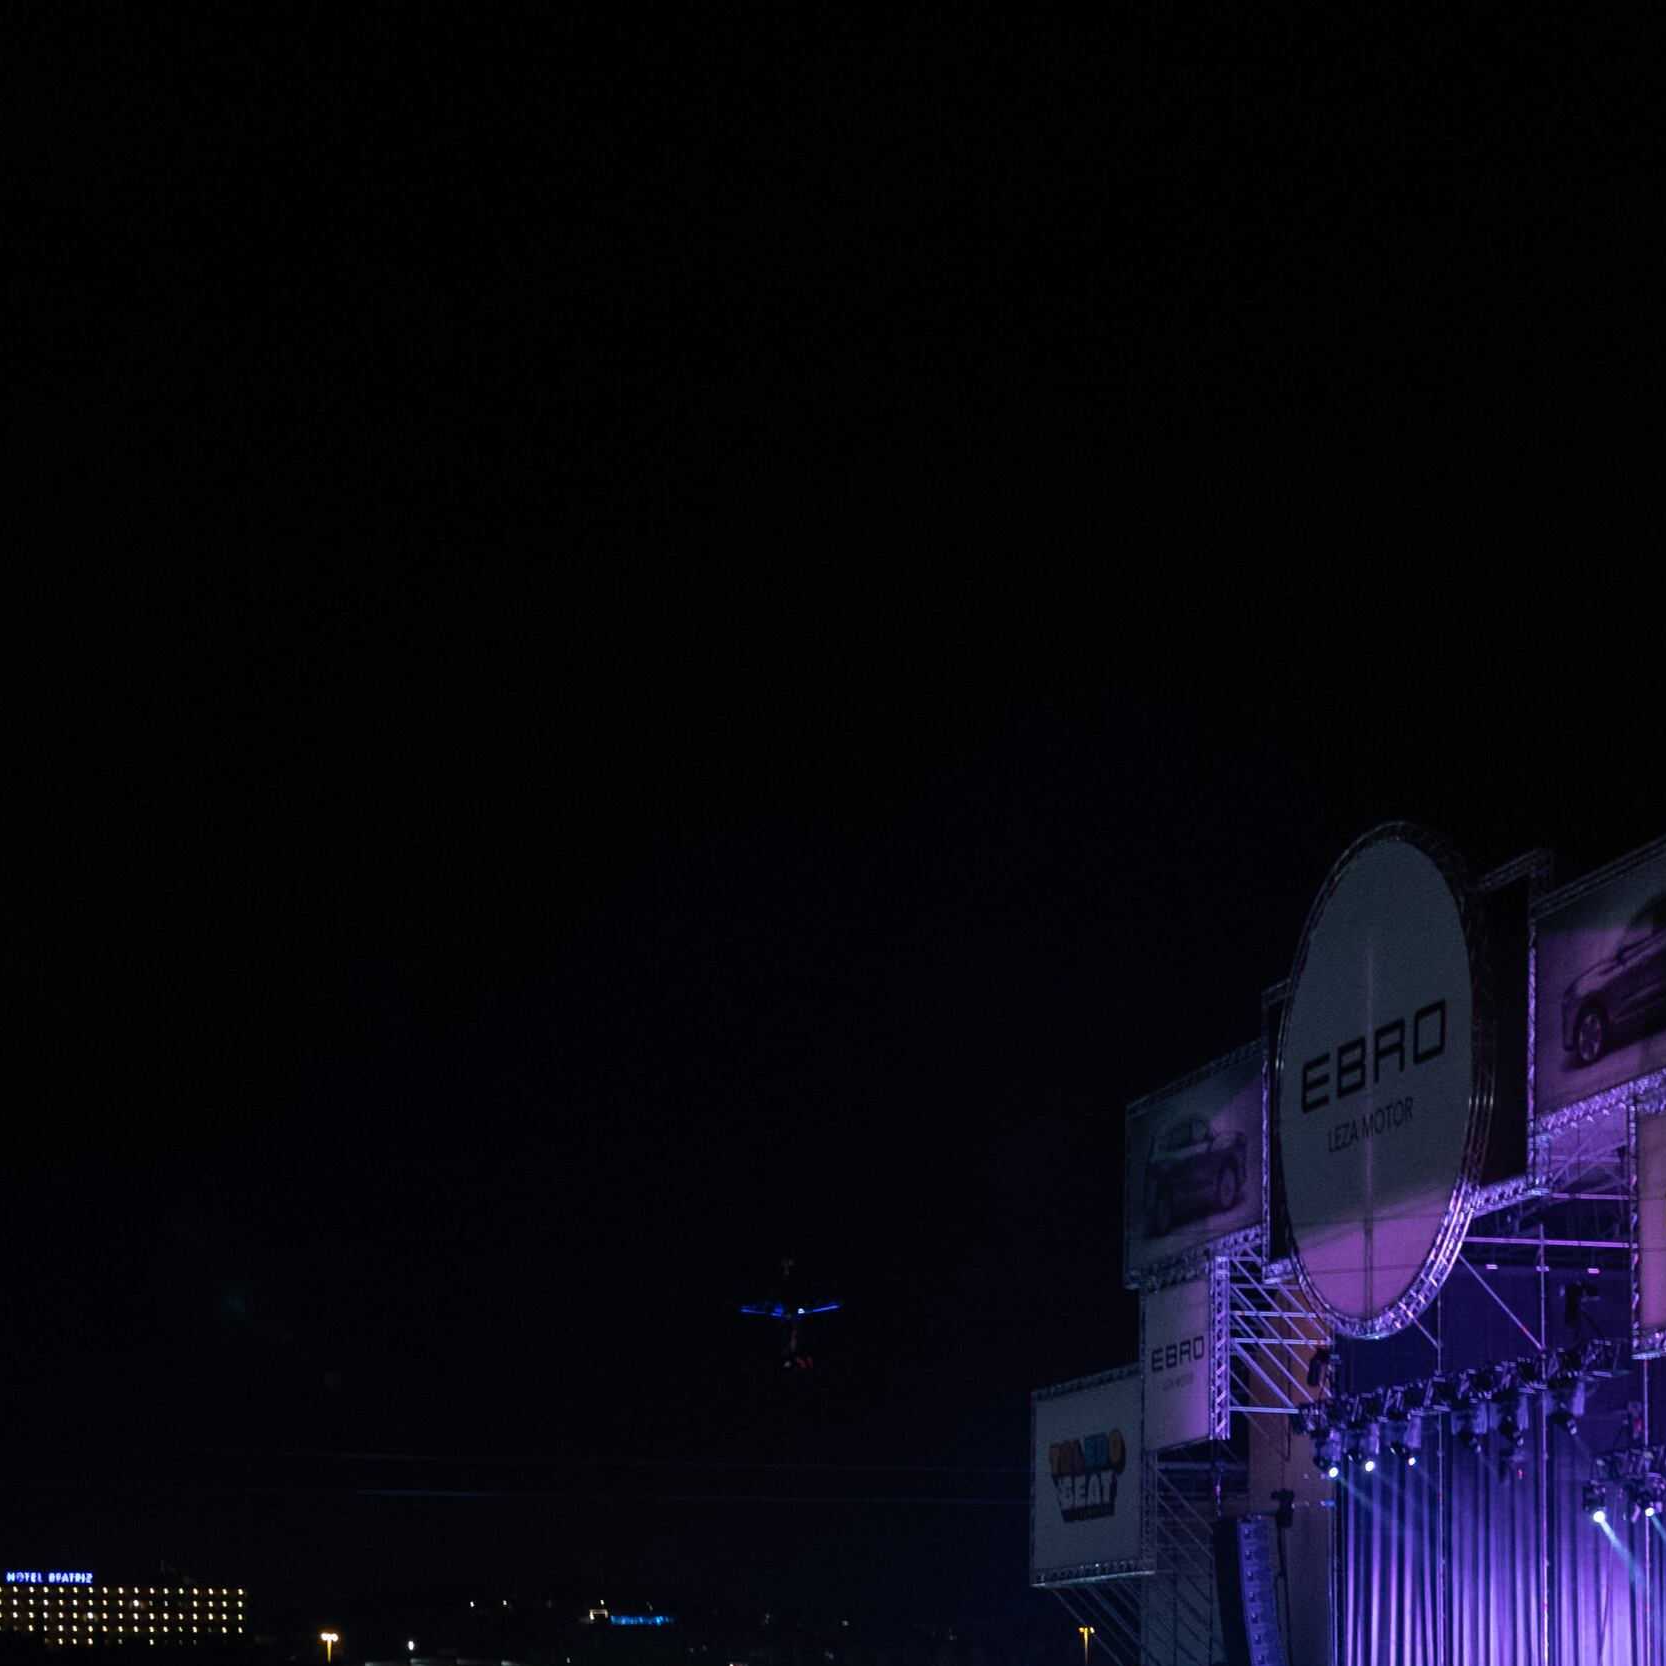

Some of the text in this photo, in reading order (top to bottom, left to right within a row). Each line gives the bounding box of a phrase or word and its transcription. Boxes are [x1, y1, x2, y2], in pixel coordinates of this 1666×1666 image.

[1302, 1000, 1446, 1113] EBRO
[1151, 1335, 1205, 1372] EBRO
[6, 1572, 93, 1583] HOTEL BEATRIZ
